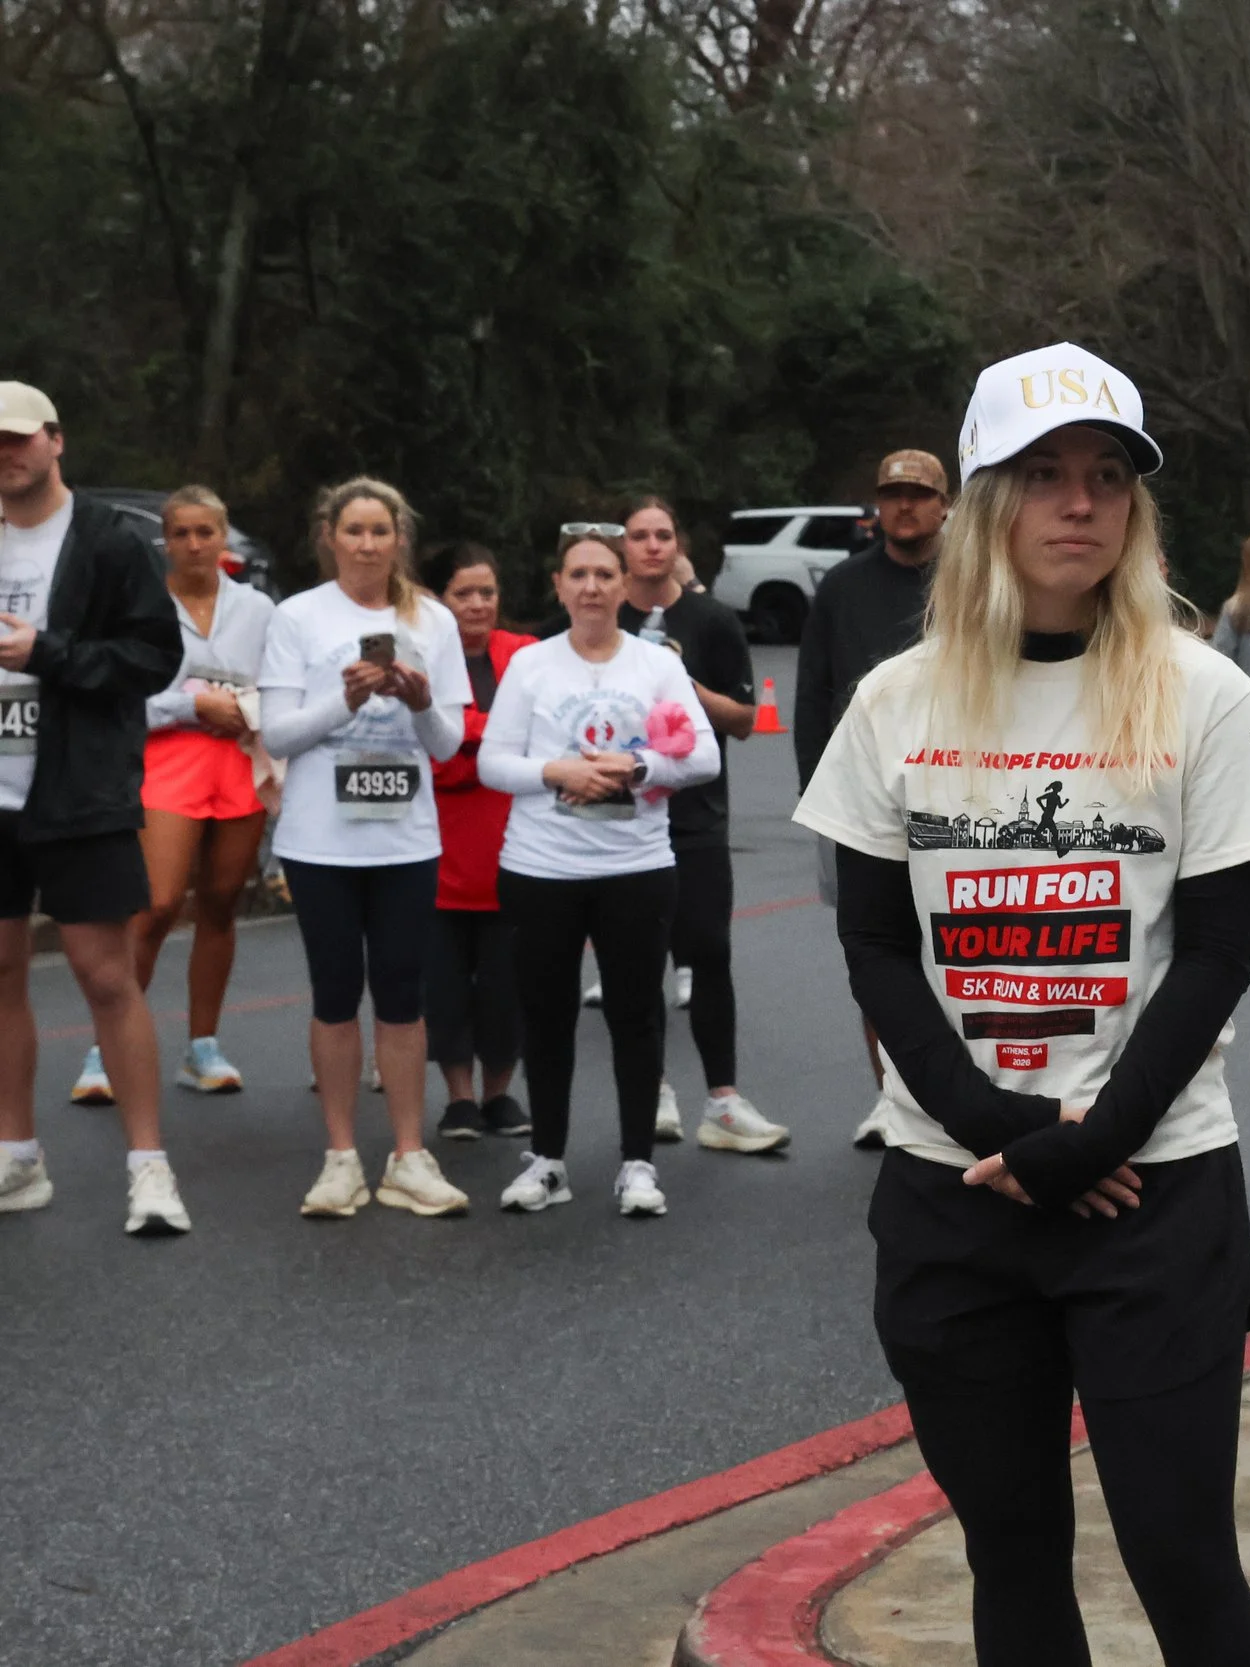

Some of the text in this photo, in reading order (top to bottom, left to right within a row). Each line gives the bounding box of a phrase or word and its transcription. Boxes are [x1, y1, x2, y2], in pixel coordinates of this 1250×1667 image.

[1018, 368, 1120, 417] USA
[0, 701, 40, 736] 49
[904, 748, 976, 767] LAKE
[977, 751, 1035, 770] HOPE
[345, 771, 409, 796] 43935
[952, 870, 1115, 909] RUN FOR
[939, 923, 1121, 958] YOUR LIFE
[962, 978, 1105, 1001] 5K RUN & WALK
[1012, 1058, 1032, 1067] 2026
[1032, 1047, 1043, 1055] GA
